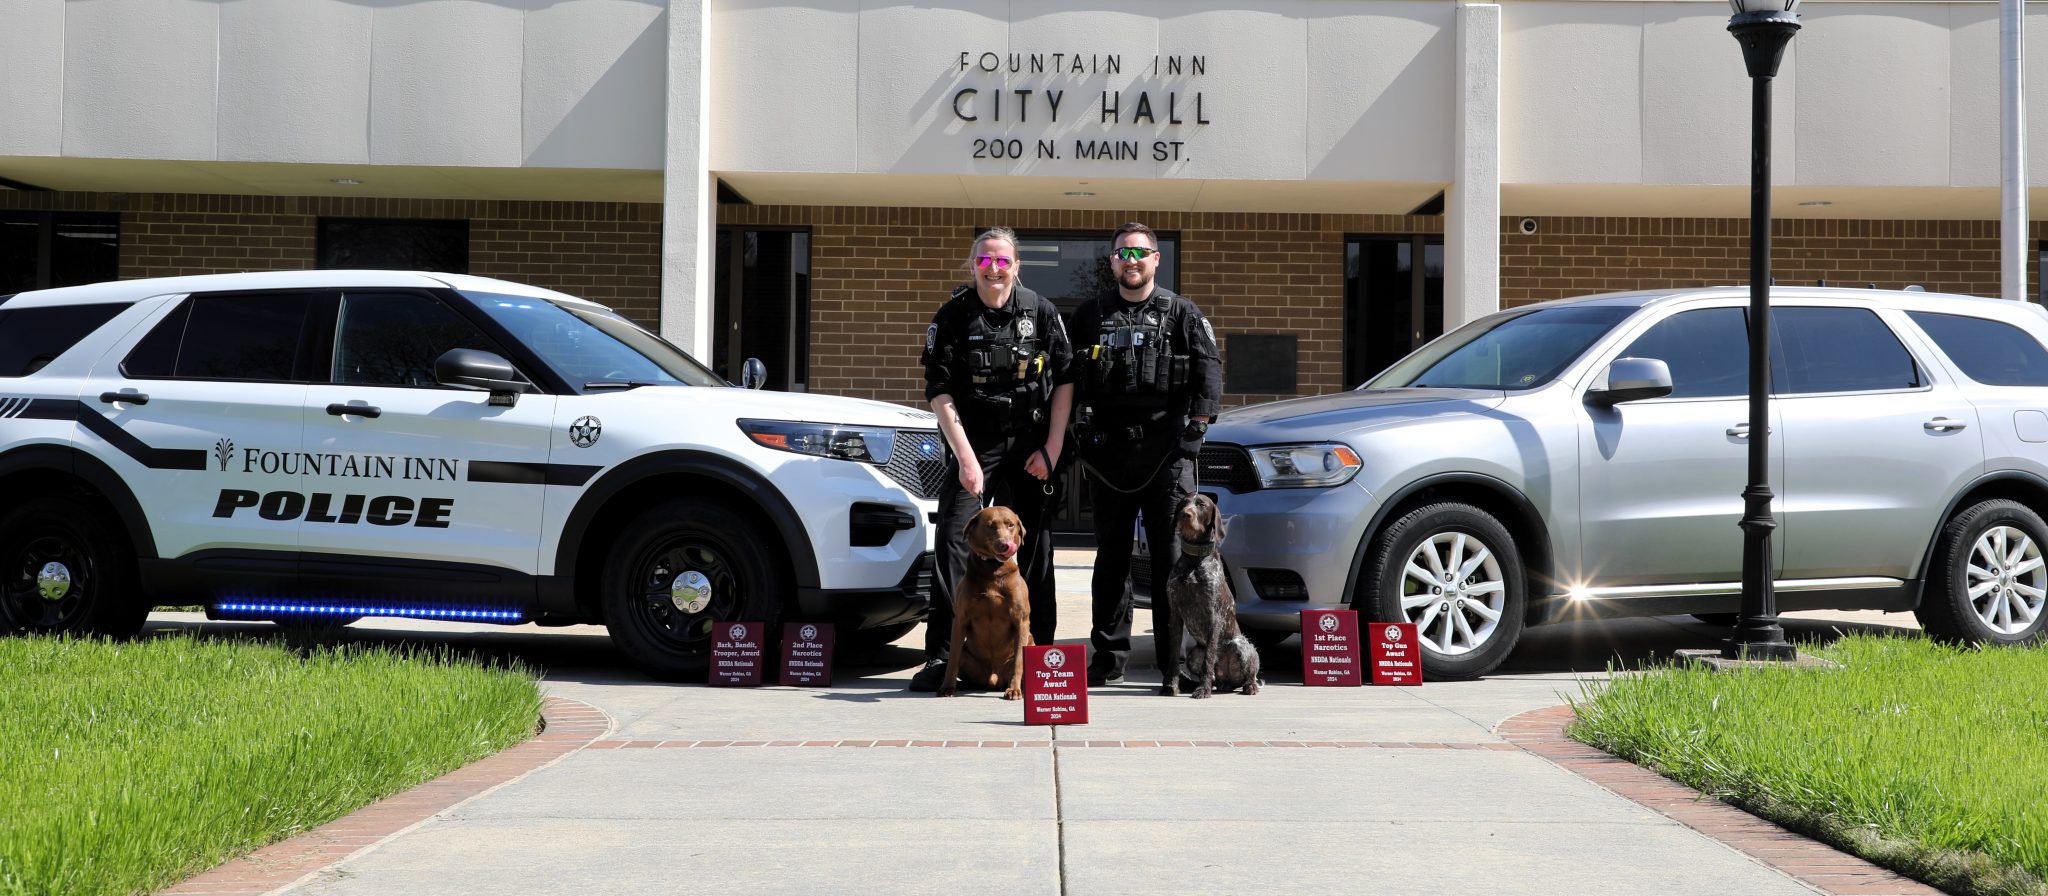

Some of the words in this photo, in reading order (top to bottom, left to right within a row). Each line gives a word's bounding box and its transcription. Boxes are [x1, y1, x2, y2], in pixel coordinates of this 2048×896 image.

[960, 51, 1121, 74] FOUNTAIN
[1154, 55, 1205, 75] INN
[953, 88, 1064, 122] CITY
[1101, 90, 1210, 125] HALL
[973, 138, 1023, 160] 200
[1037, 139, 1061, 160] N.
[1075, 139, 1138, 161] MAIN
[1152, 141, 1190, 162] ST.
[242, 448, 395, 479] FOUNTAIN
[402, 457, 459, 482] INN
[212, 489, 455, 529] POLICE
[1313, 643, 1348, 651] Narcotics
[1329, 656, 1351, 664] Nationals
[1036, 670, 1051, 679] Top
[1052, 670, 1075, 678] Team
[1043, 680, 1067, 688] Award
